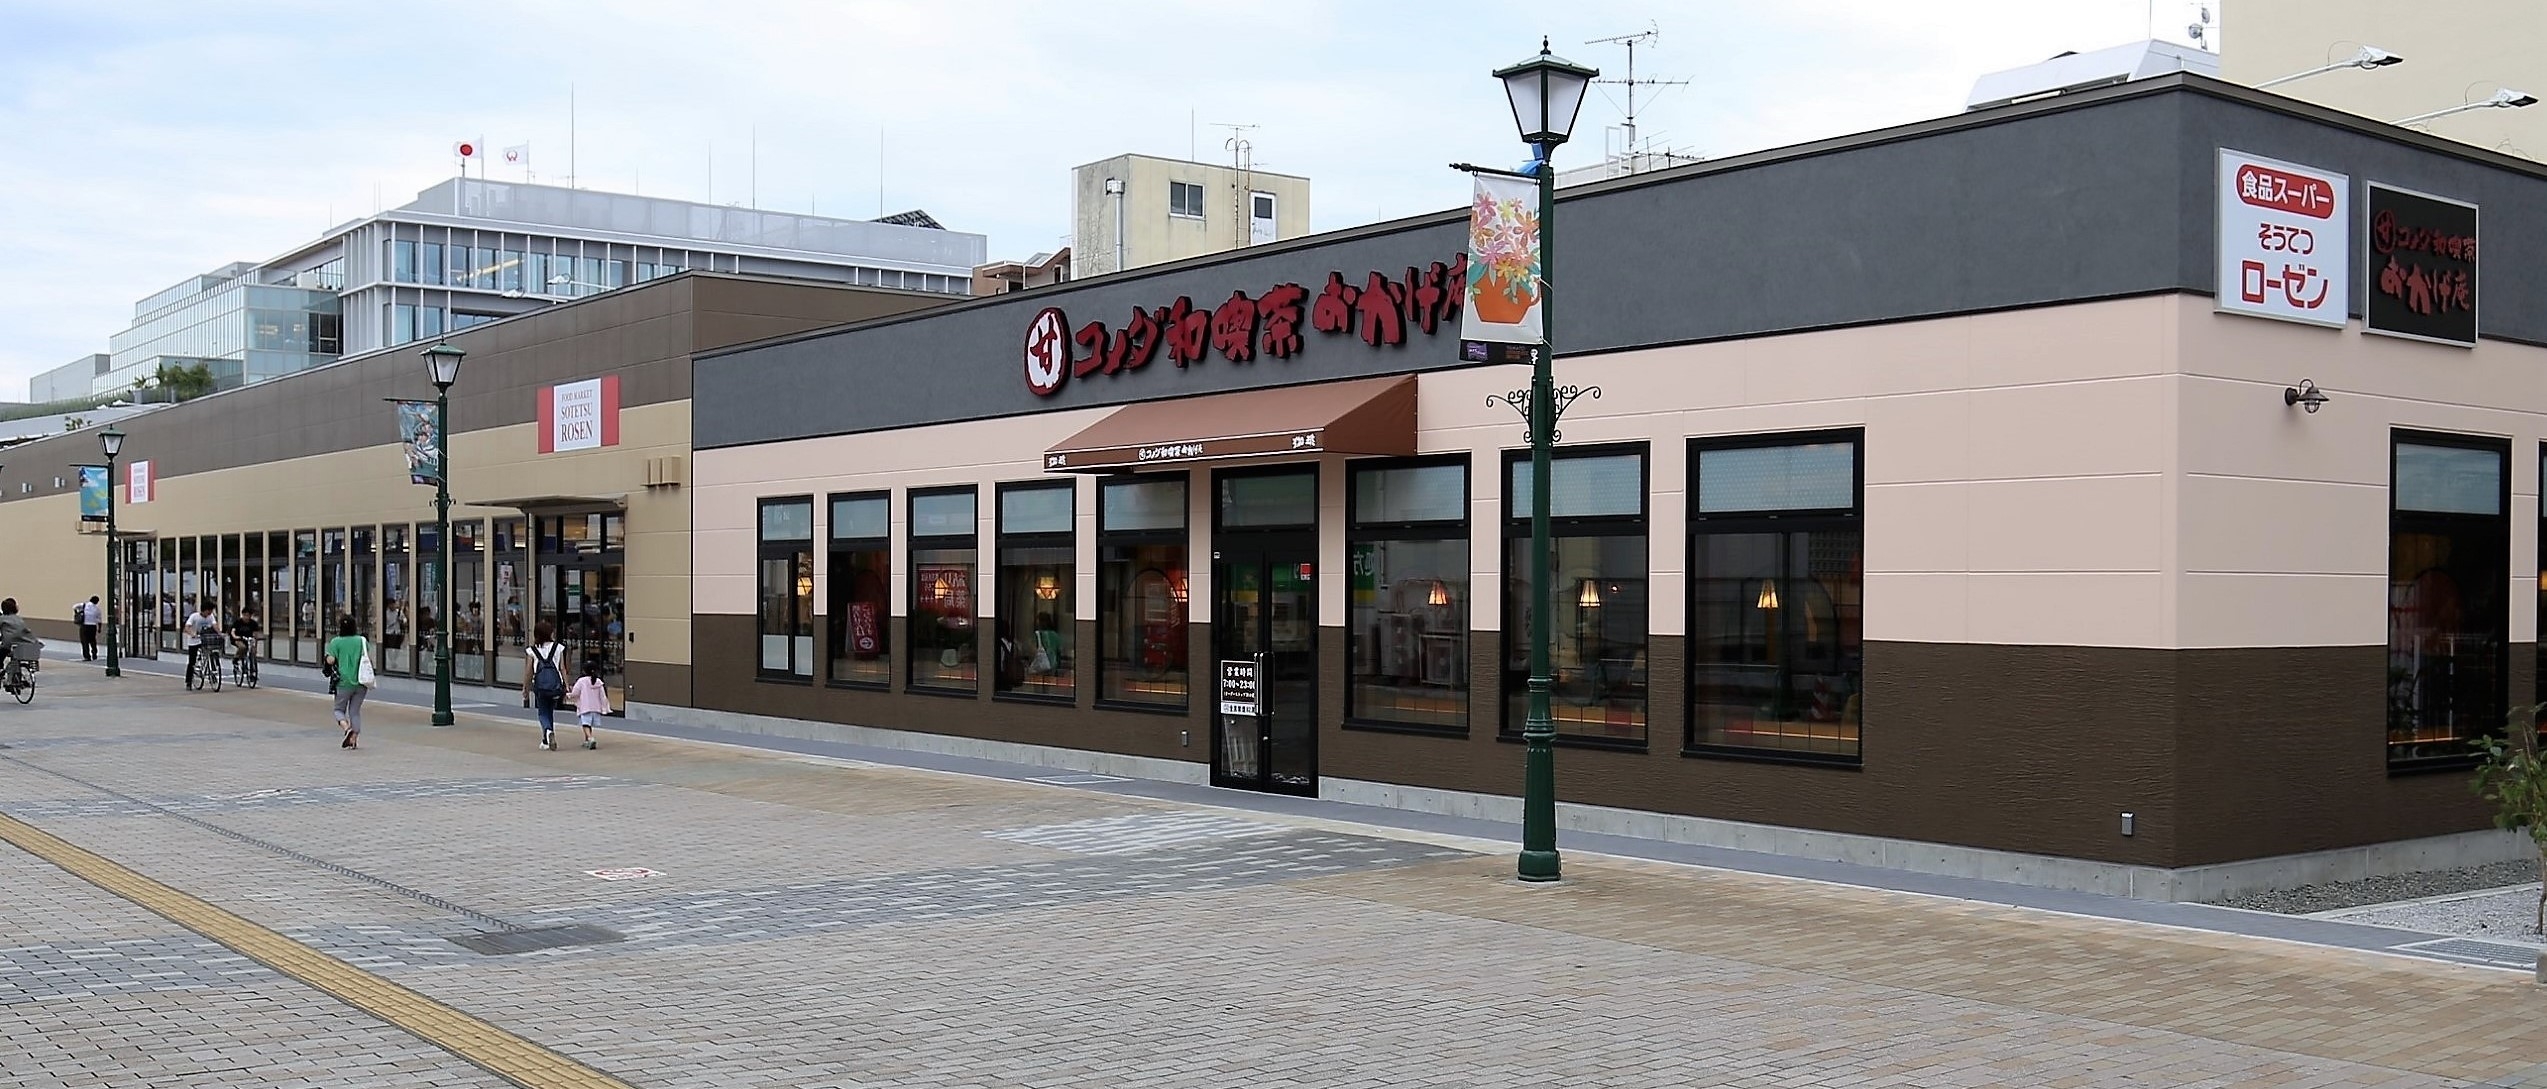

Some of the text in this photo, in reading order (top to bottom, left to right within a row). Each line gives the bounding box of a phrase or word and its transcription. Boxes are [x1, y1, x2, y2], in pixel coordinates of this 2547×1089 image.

[2241, 170, 2330, 210] 食品スーパー
[2258, 222, 2314, 256] そうてつ
[2241, 259, 2329, 310] ローゼン
[561, 389, 593, 402] FOOD MARKET
[561, 402, 593, 420] SOTETSU
[561, 420, 593, 442] ROSEN
